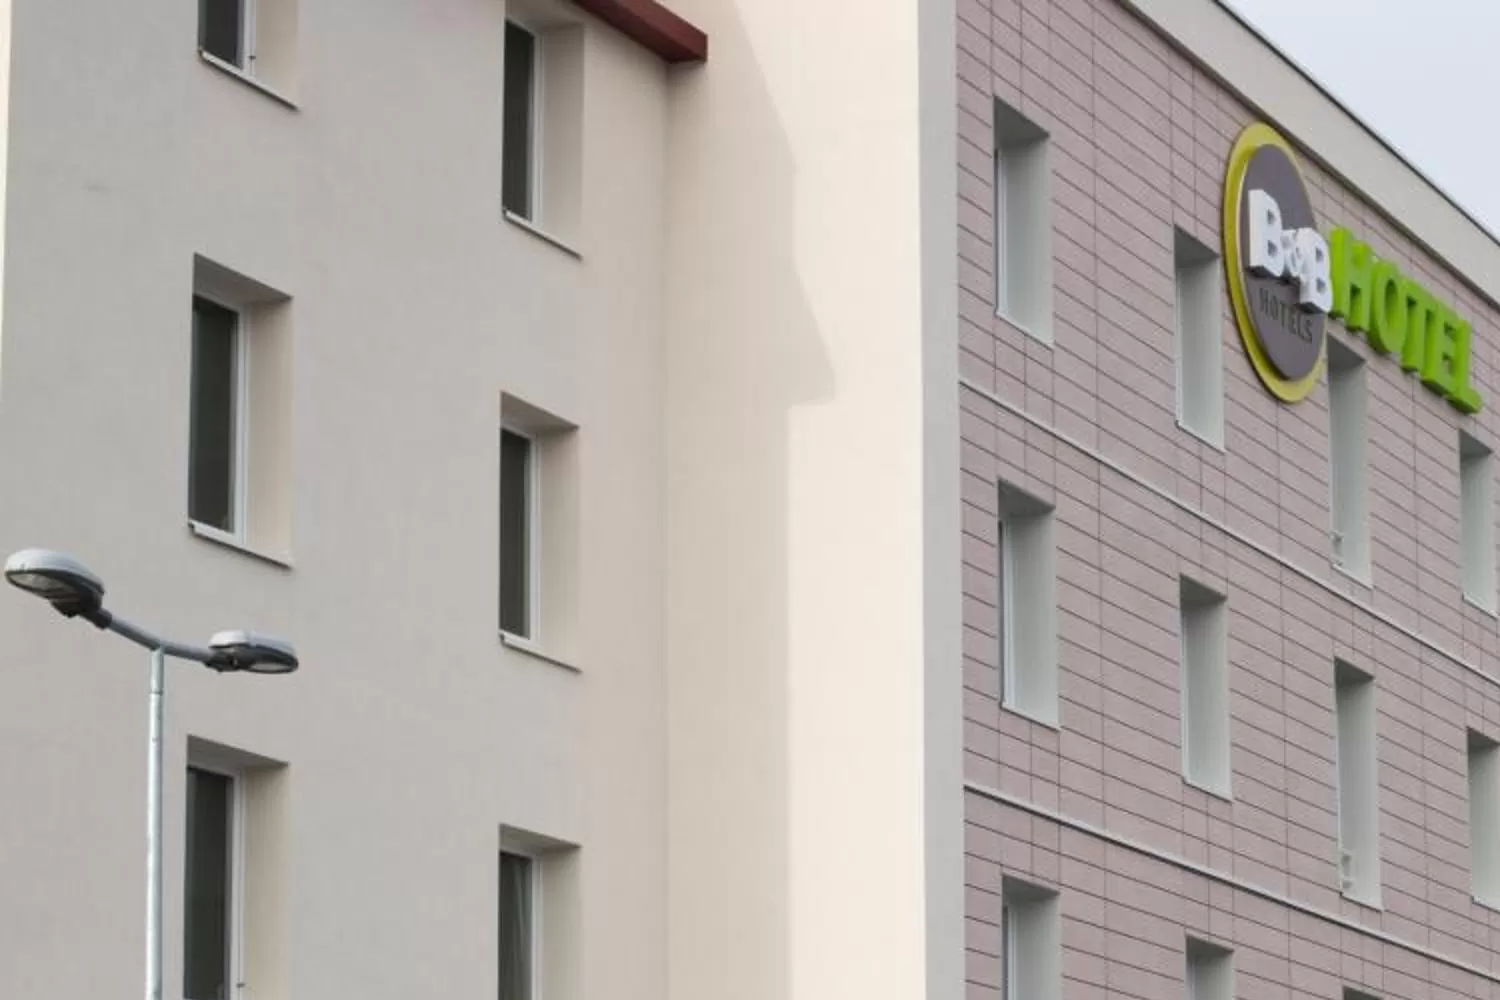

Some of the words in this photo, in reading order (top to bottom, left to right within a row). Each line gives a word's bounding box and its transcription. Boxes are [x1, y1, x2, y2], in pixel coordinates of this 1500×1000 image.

[1247, 189, 1332, 314] B&B
[1259, 287, 1313, 345] HOTELS
[1328, 226, 1483, 414] HOTEL
